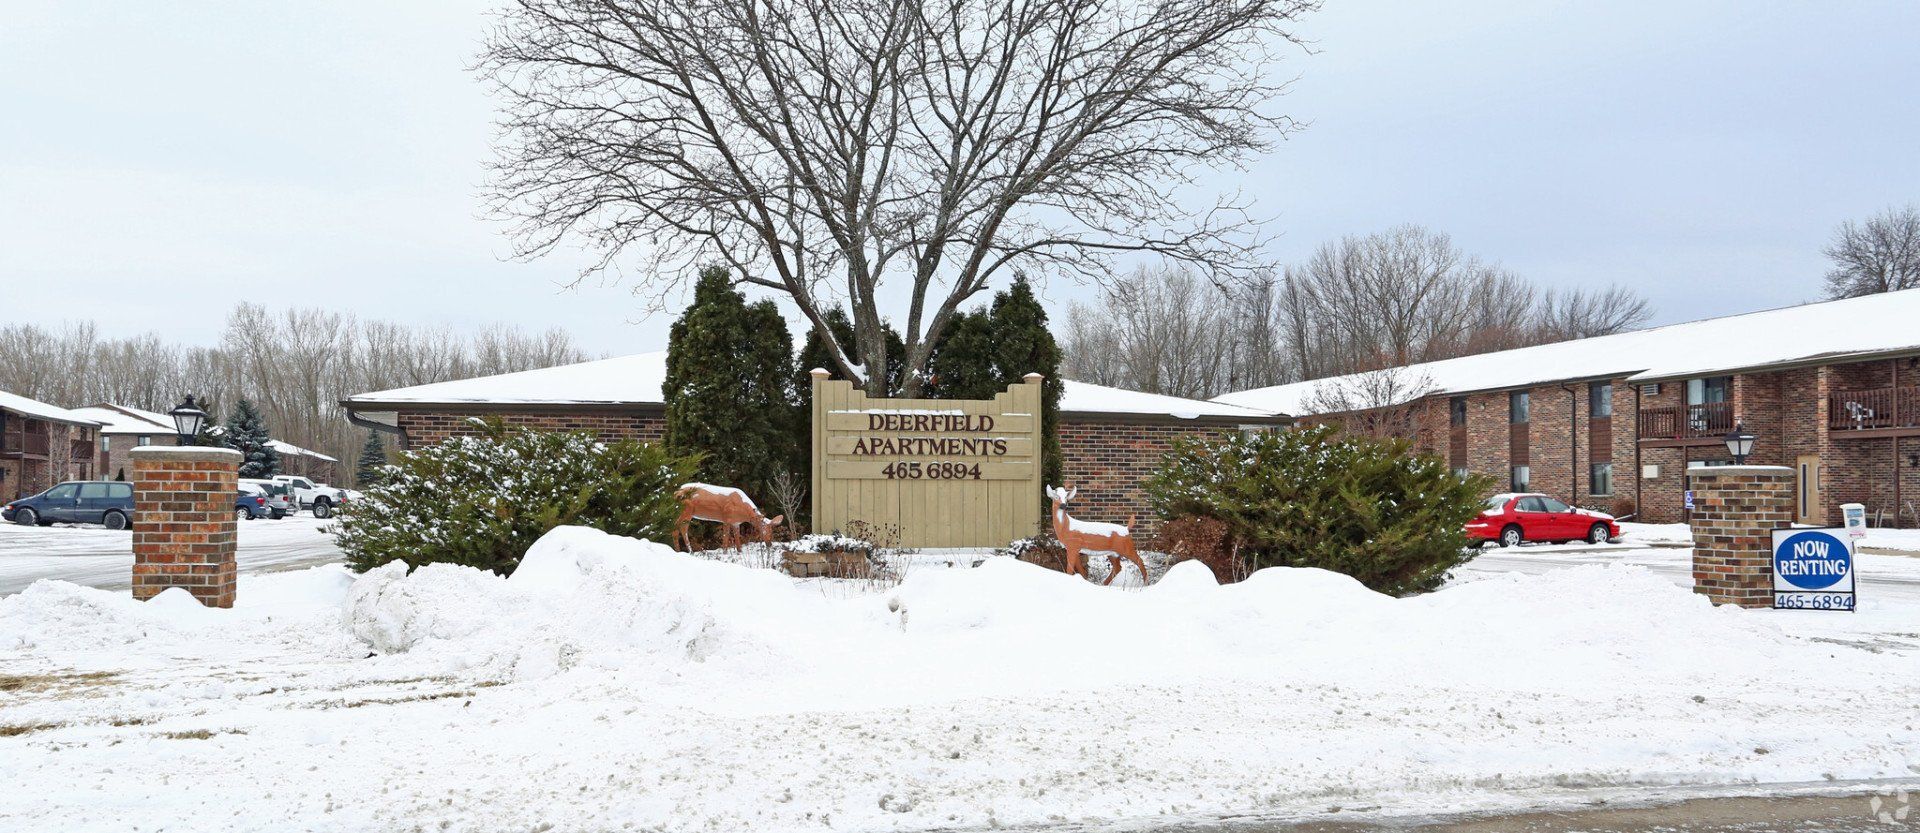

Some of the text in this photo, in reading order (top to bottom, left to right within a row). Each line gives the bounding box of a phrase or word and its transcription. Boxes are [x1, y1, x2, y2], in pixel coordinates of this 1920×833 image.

[868, 413, 994, 432] DEERFIELD
[852, 437, 1007, 456] APARTMENTS
[881, 462, 982, 480] 465 6894
[1794, 540, 1829, 559] NOW
[1780, 560, 1846, 576] RENTING
[1777, 594, 1853, 609] 465-6894
